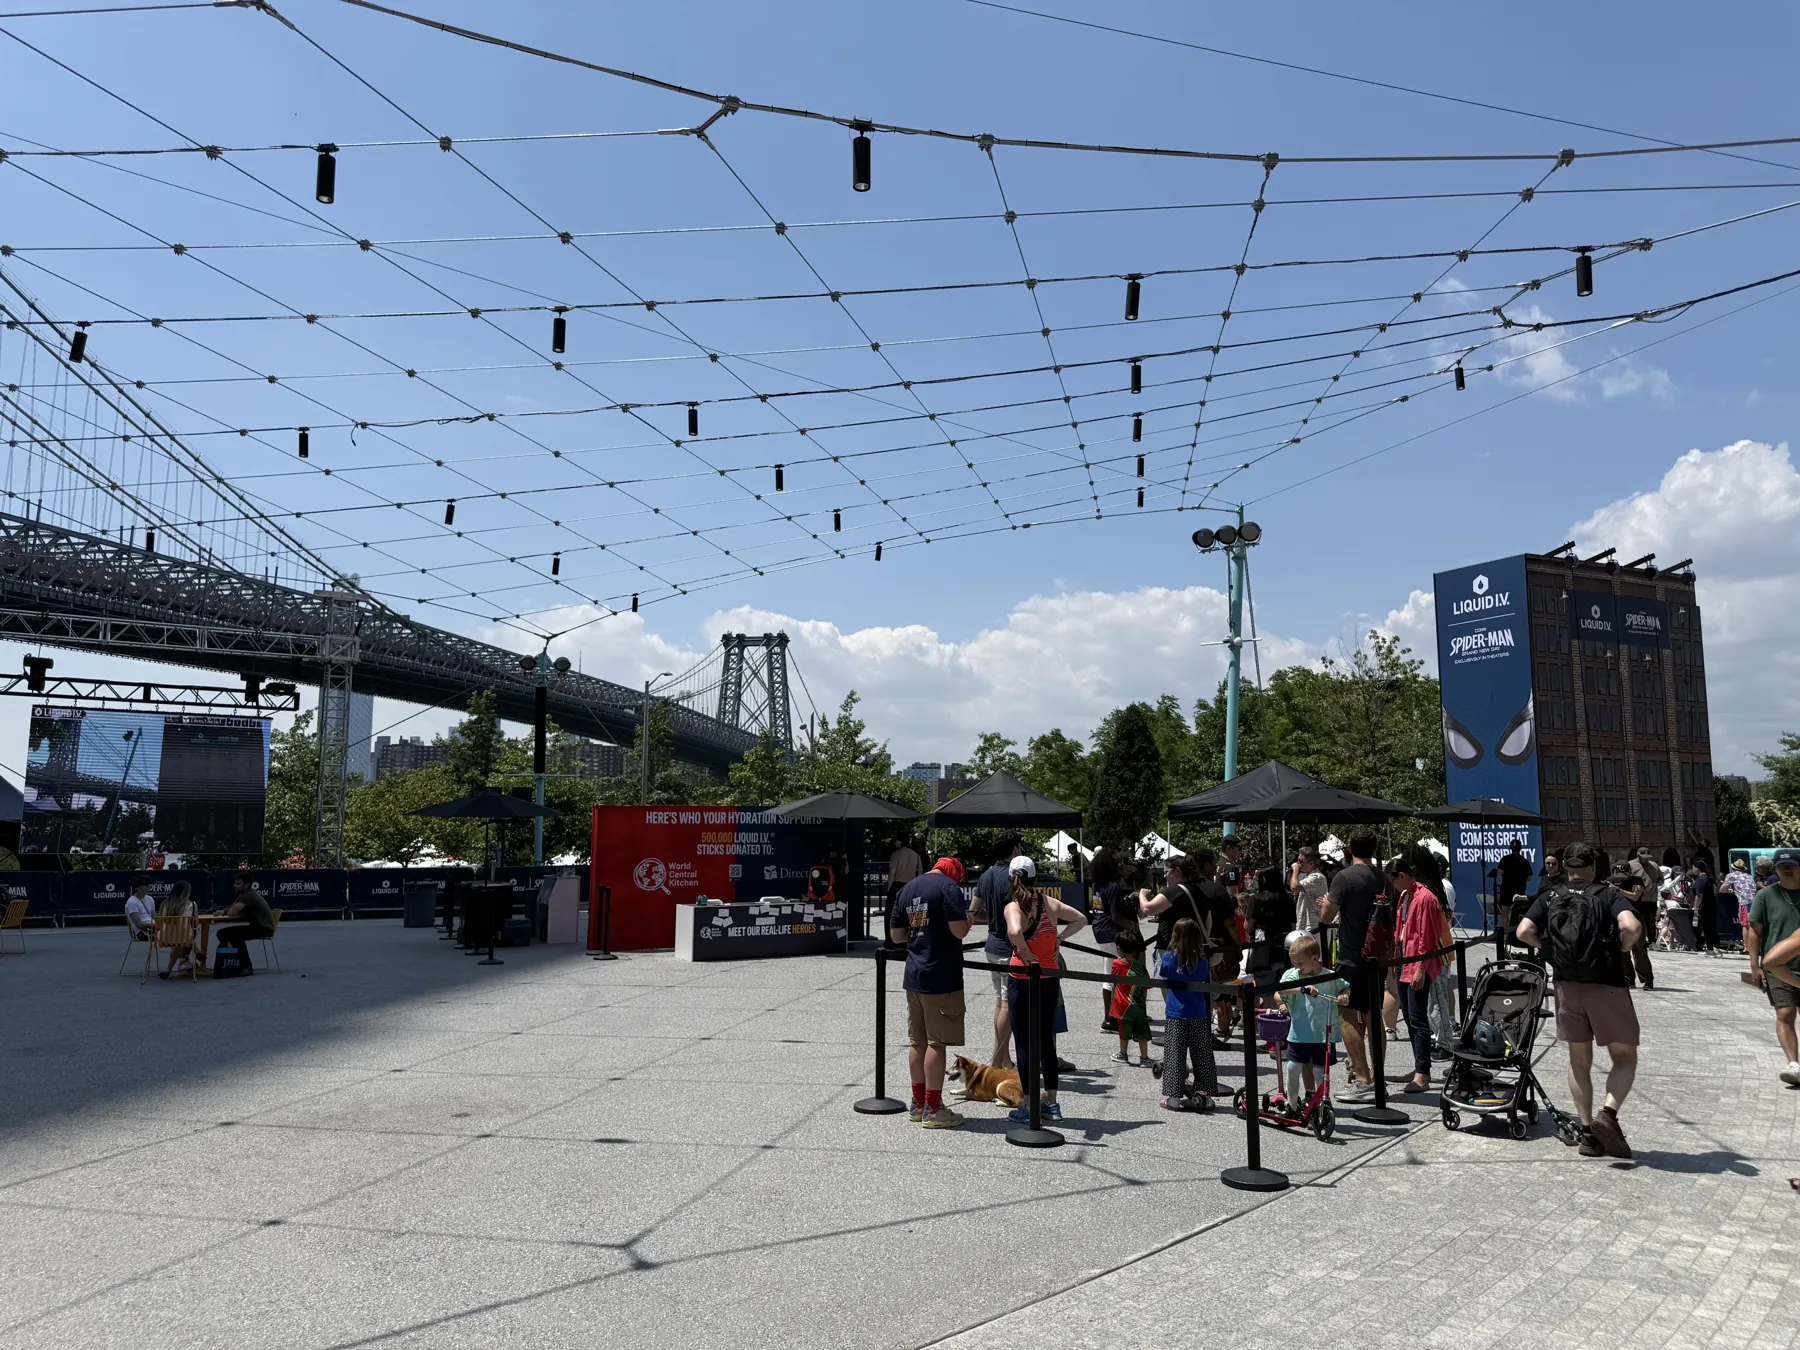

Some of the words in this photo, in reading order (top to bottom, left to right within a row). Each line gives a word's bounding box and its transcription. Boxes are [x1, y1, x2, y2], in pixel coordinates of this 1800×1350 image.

[1453, 595, 1494, 615] LIQUID
[1496, 592, 1511, 607] I.V.
[1580, 618, 1603, 630] LIQUID
[1625, 613, 1662, 631] SPIDER-MAN
[1450, 629, 1515, 657] SPIDER-MAN
[1454, 656, 1481, 665] EXCLUSIVELY
[1487, 652, 1510, 660] THEATERS
[645, 811, 678, 824] HERE'S
[679, 811, 700, 824] WHO
[702, 811, 726, 824] YOUR
[728, 811, 776, 824] HYDRATION
[778, 814, 823, 825] SUPPORTS
[701, 832, 732, 844] 500,000
[734, 832, 759, 844] LIQUID
[1460, 831, 1494, 846] COMES
[1496, 831, 1529, 846] GREAT
[697, 844, 724, 855] STICKS
[726, 844, 761, 855] DONATED
[762, 844, 774, 855] TO:
[668, 862, 692, 870] World
[669, 870, 698, 879] Central
[780, 868, 809, 879] Direct
[278, 882, 320, 893] SPIDER-MAN
[669, 879, 699, 887] Kitchen
[728, 926, 746, 937] MEET
[747, 926, 761, 936] OUR
[761, 925, 791, 936] REAL-LIFE
[792, 923, 816, 934] HEROES
